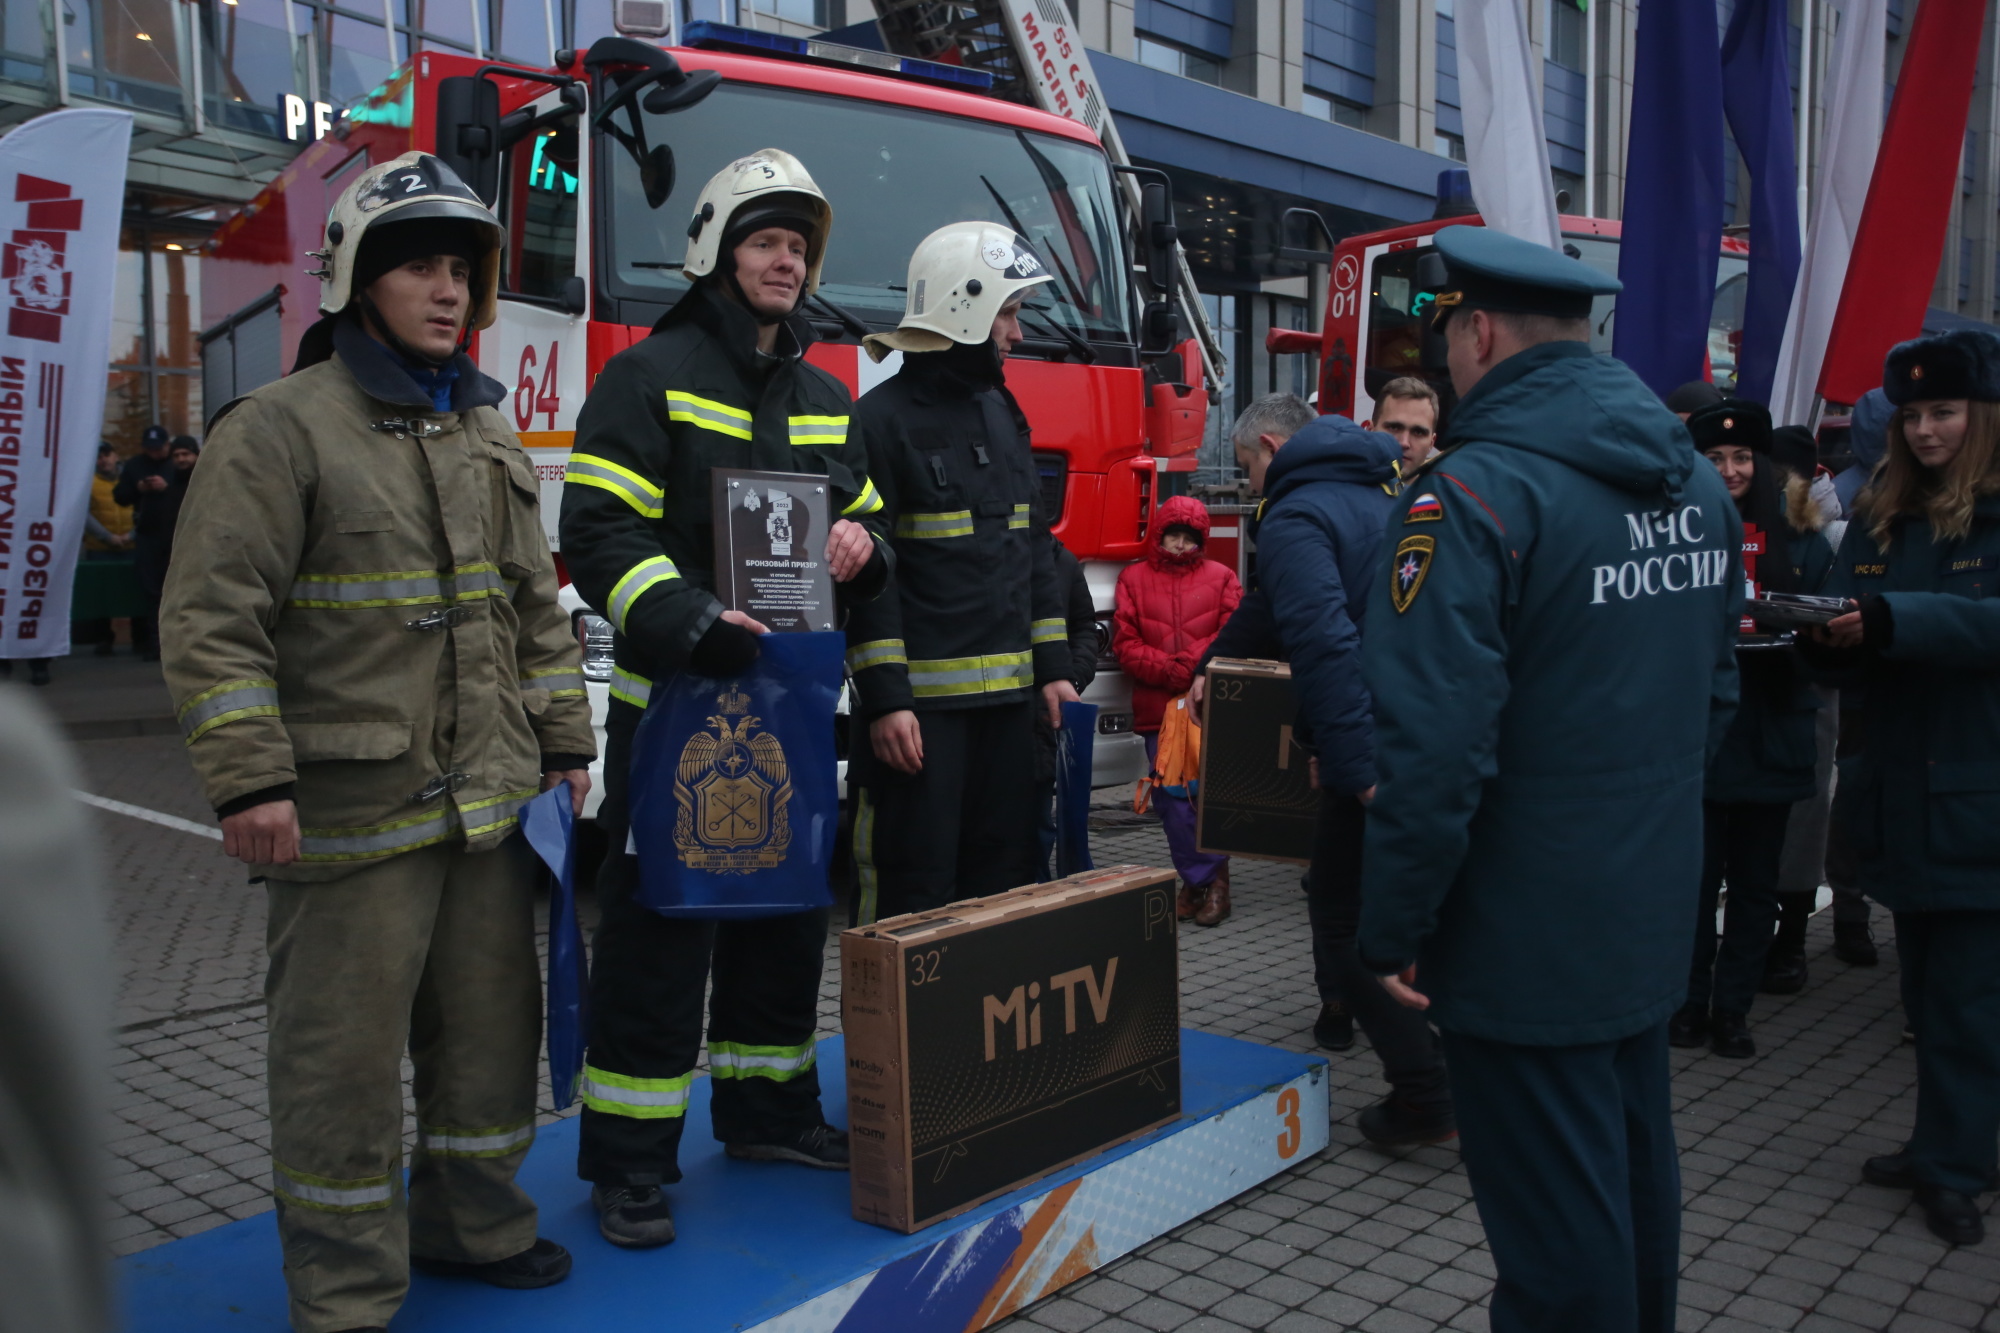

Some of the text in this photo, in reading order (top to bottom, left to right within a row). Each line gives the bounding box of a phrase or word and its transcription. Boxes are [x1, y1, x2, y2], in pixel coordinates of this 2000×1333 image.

[400, 174, 427, 193] 2
[762, 166, 775, 180] 5
[989, 247, 1006, 260] 58
[1332, 289, 1357, 319] 01
[514, 340, 560, 432] 64
[1623, 505, 1705, 551] МЧС
[17, 521, 54, 640] ВЫЗОВ
[746, 559, 818, 569] БРОНЗОВЫЙ ПРИЗЕР
[1588, 549, 1729, 605] РОССИИ
[983, 956, 1119, 1062] Mi TV
[860, 1059, 884, 1077] Dolby
[1276, 1087, 1301, 1159] 3
